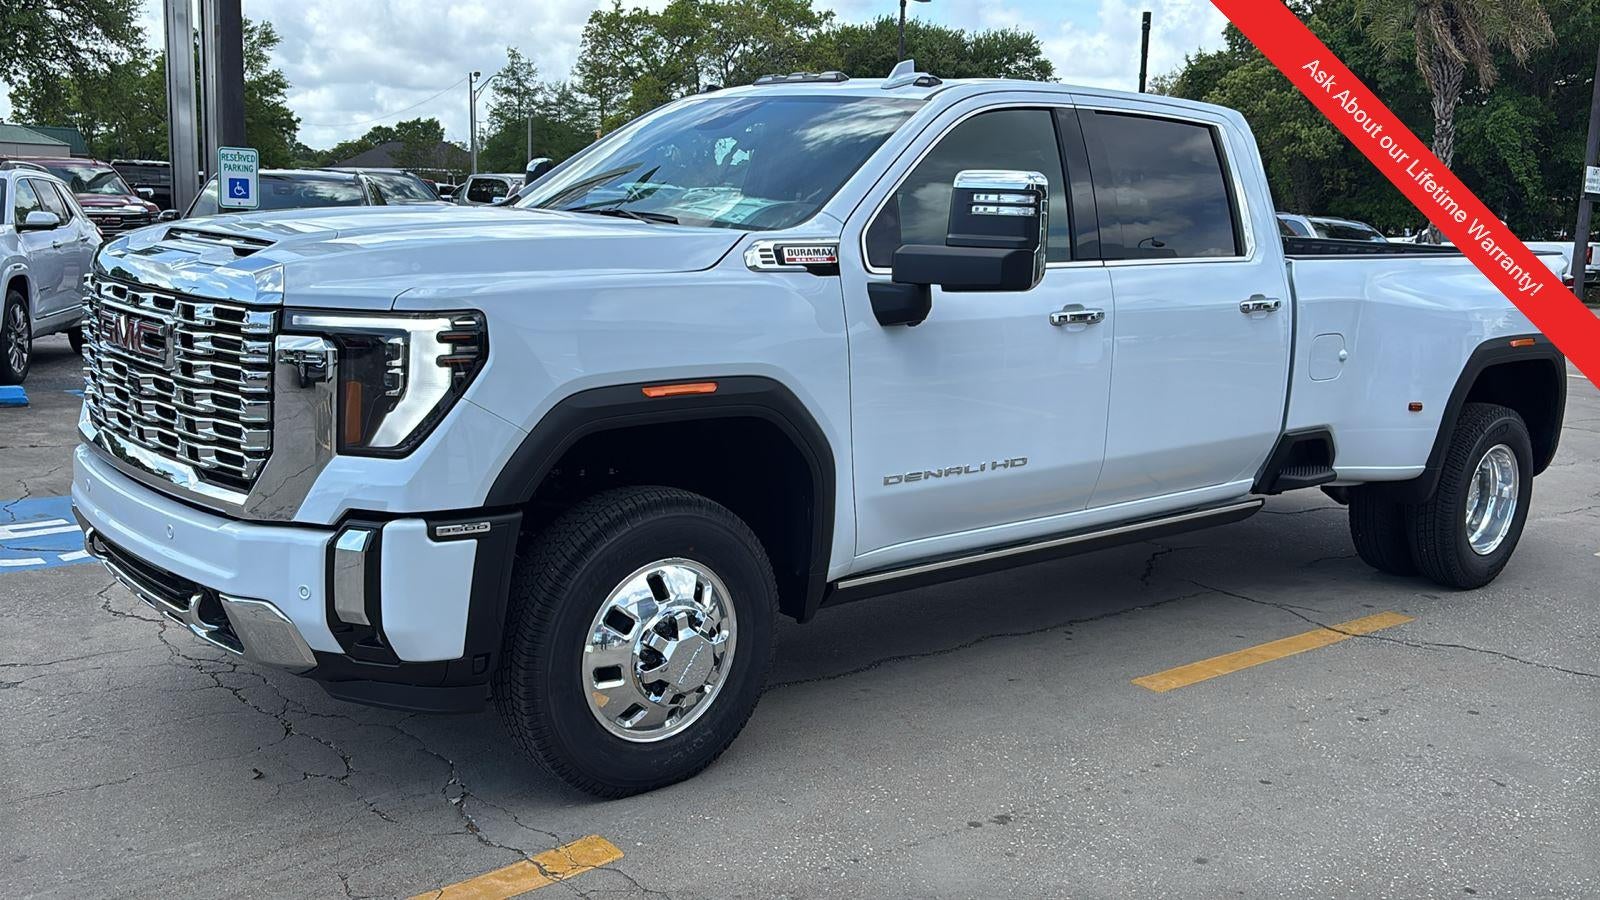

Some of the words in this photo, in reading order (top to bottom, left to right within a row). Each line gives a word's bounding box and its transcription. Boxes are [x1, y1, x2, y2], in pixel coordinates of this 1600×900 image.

[221, 153, 256, 163] RESERVED
[224, 163, 254, 173] PARKING
[787, 248, 833, 257] DURAMAX
[100, 308, 165, 361] GMC
[883, 461, 987, 486] DENALI
[991, 457, 1029, 471] HD
[436, 522, 491, 536] 3500
